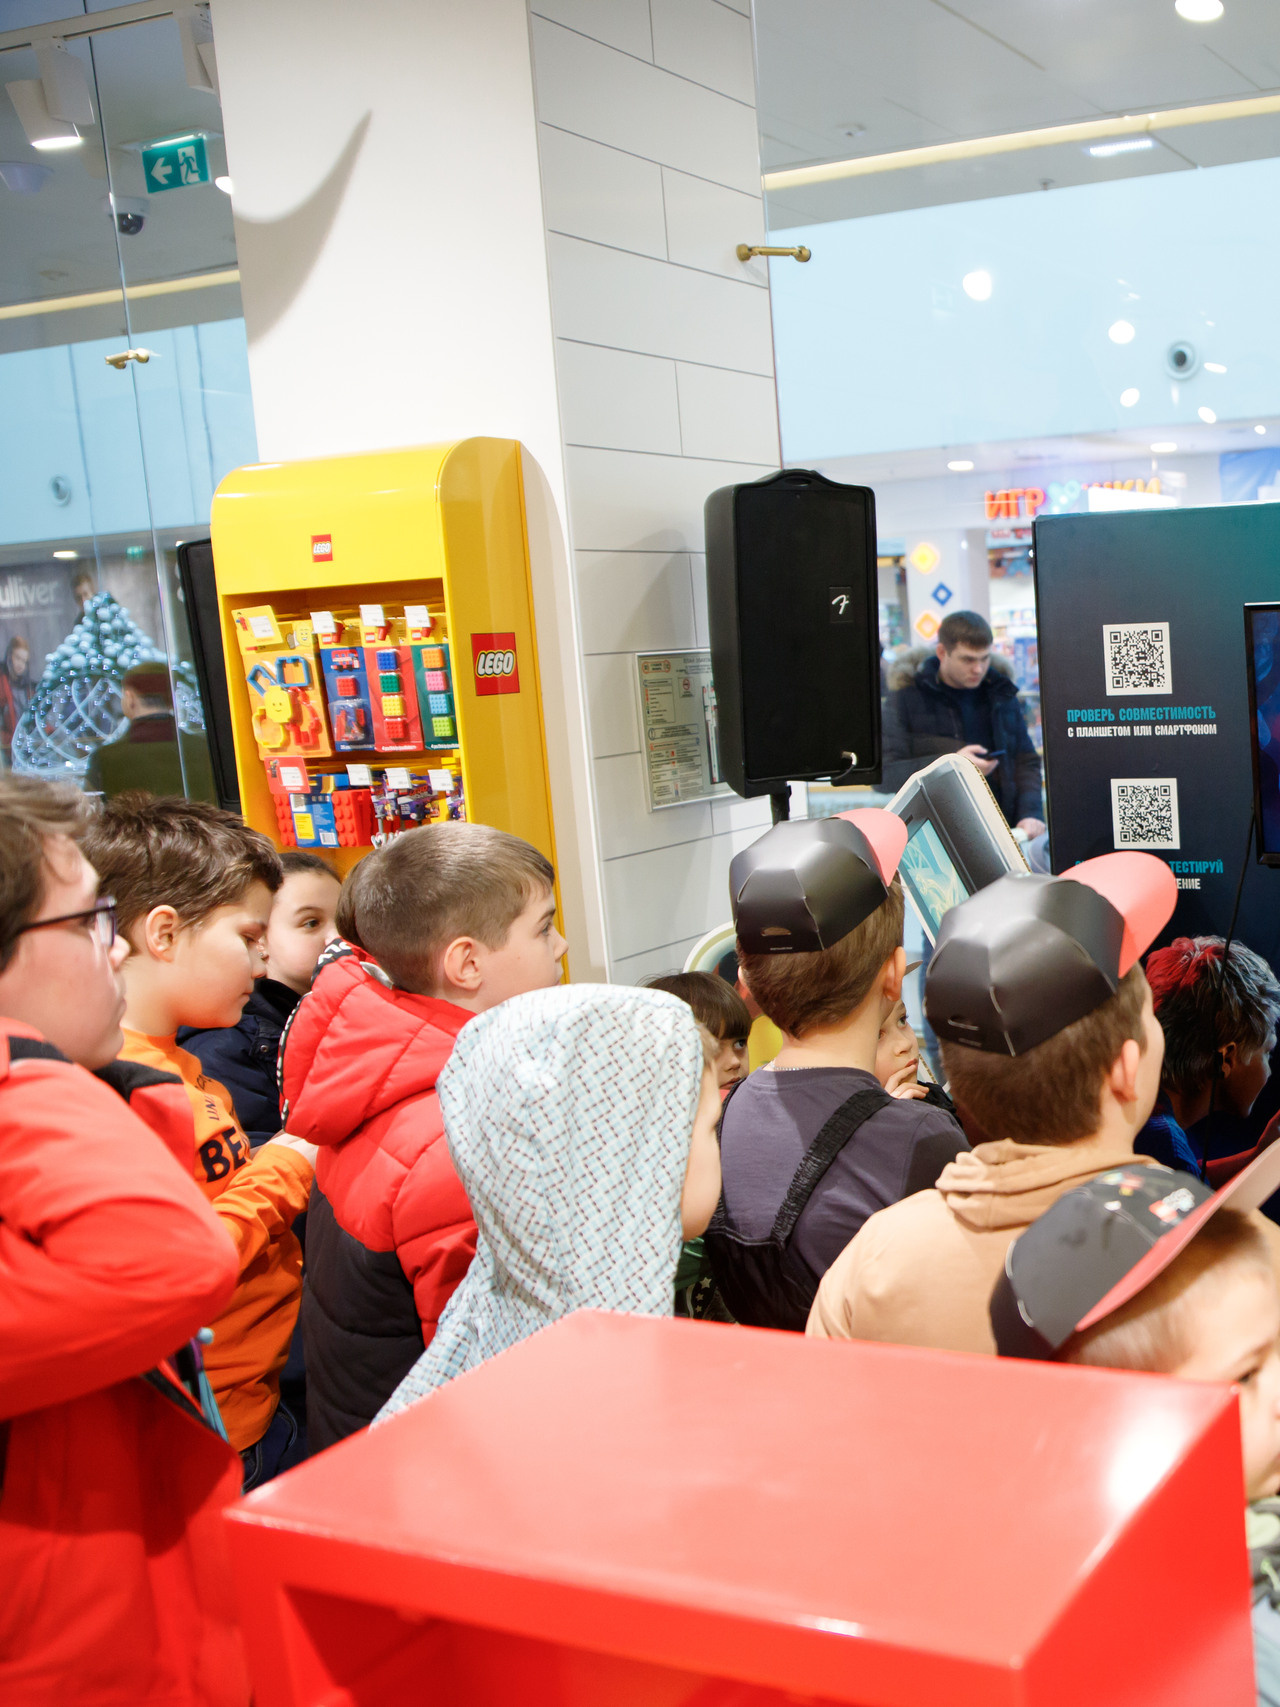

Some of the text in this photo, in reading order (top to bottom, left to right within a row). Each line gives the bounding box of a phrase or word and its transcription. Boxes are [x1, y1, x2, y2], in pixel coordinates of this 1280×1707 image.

[312, 542, 332, 555] LEGO
[476, 650, 515, 676] LEGO
[1067, 706, 1216, 722] ПРОВЕРЬ СОВМЕСТИМОСТЬ
[1067, 724, 1217, 737] С ПЛАНШЕТОМ ИЛИ СМАРТФОНОМ
[1168, 859, 1224, 874] ТЕСТИРУЙ
[1175, 878, 1201, 890] ЕНИЕ
